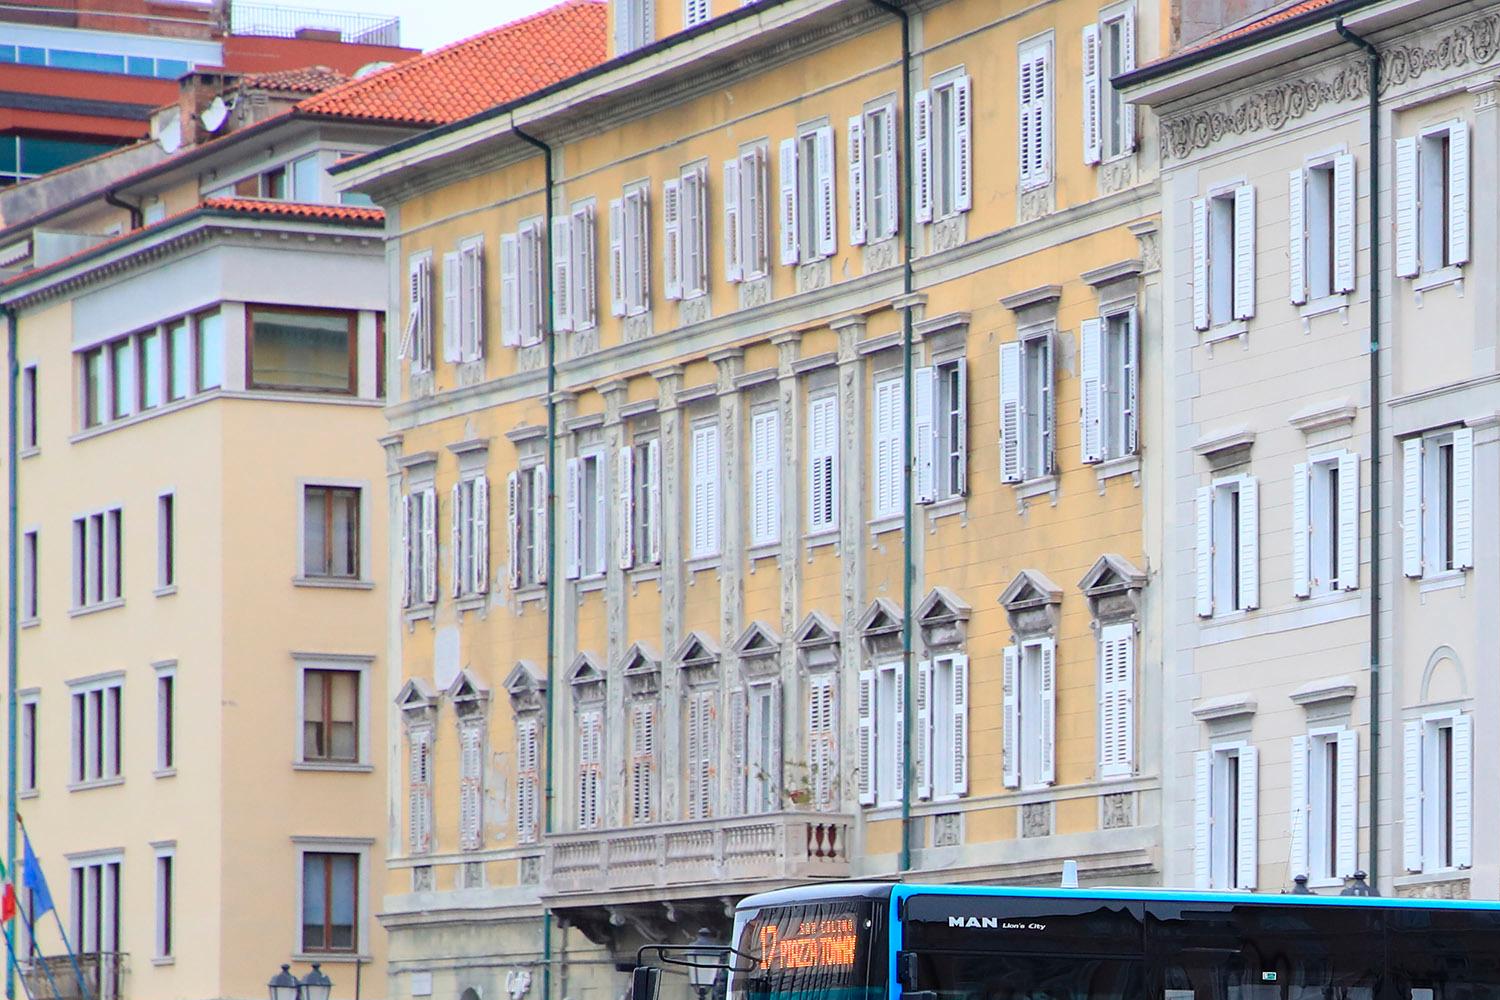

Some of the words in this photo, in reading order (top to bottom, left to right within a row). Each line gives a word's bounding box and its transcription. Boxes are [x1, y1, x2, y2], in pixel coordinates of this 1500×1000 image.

[948, 916, 998, 928] MAN
[760, 926, 777, 969] 17
[780, 938, 818, 968] PIAZZA
